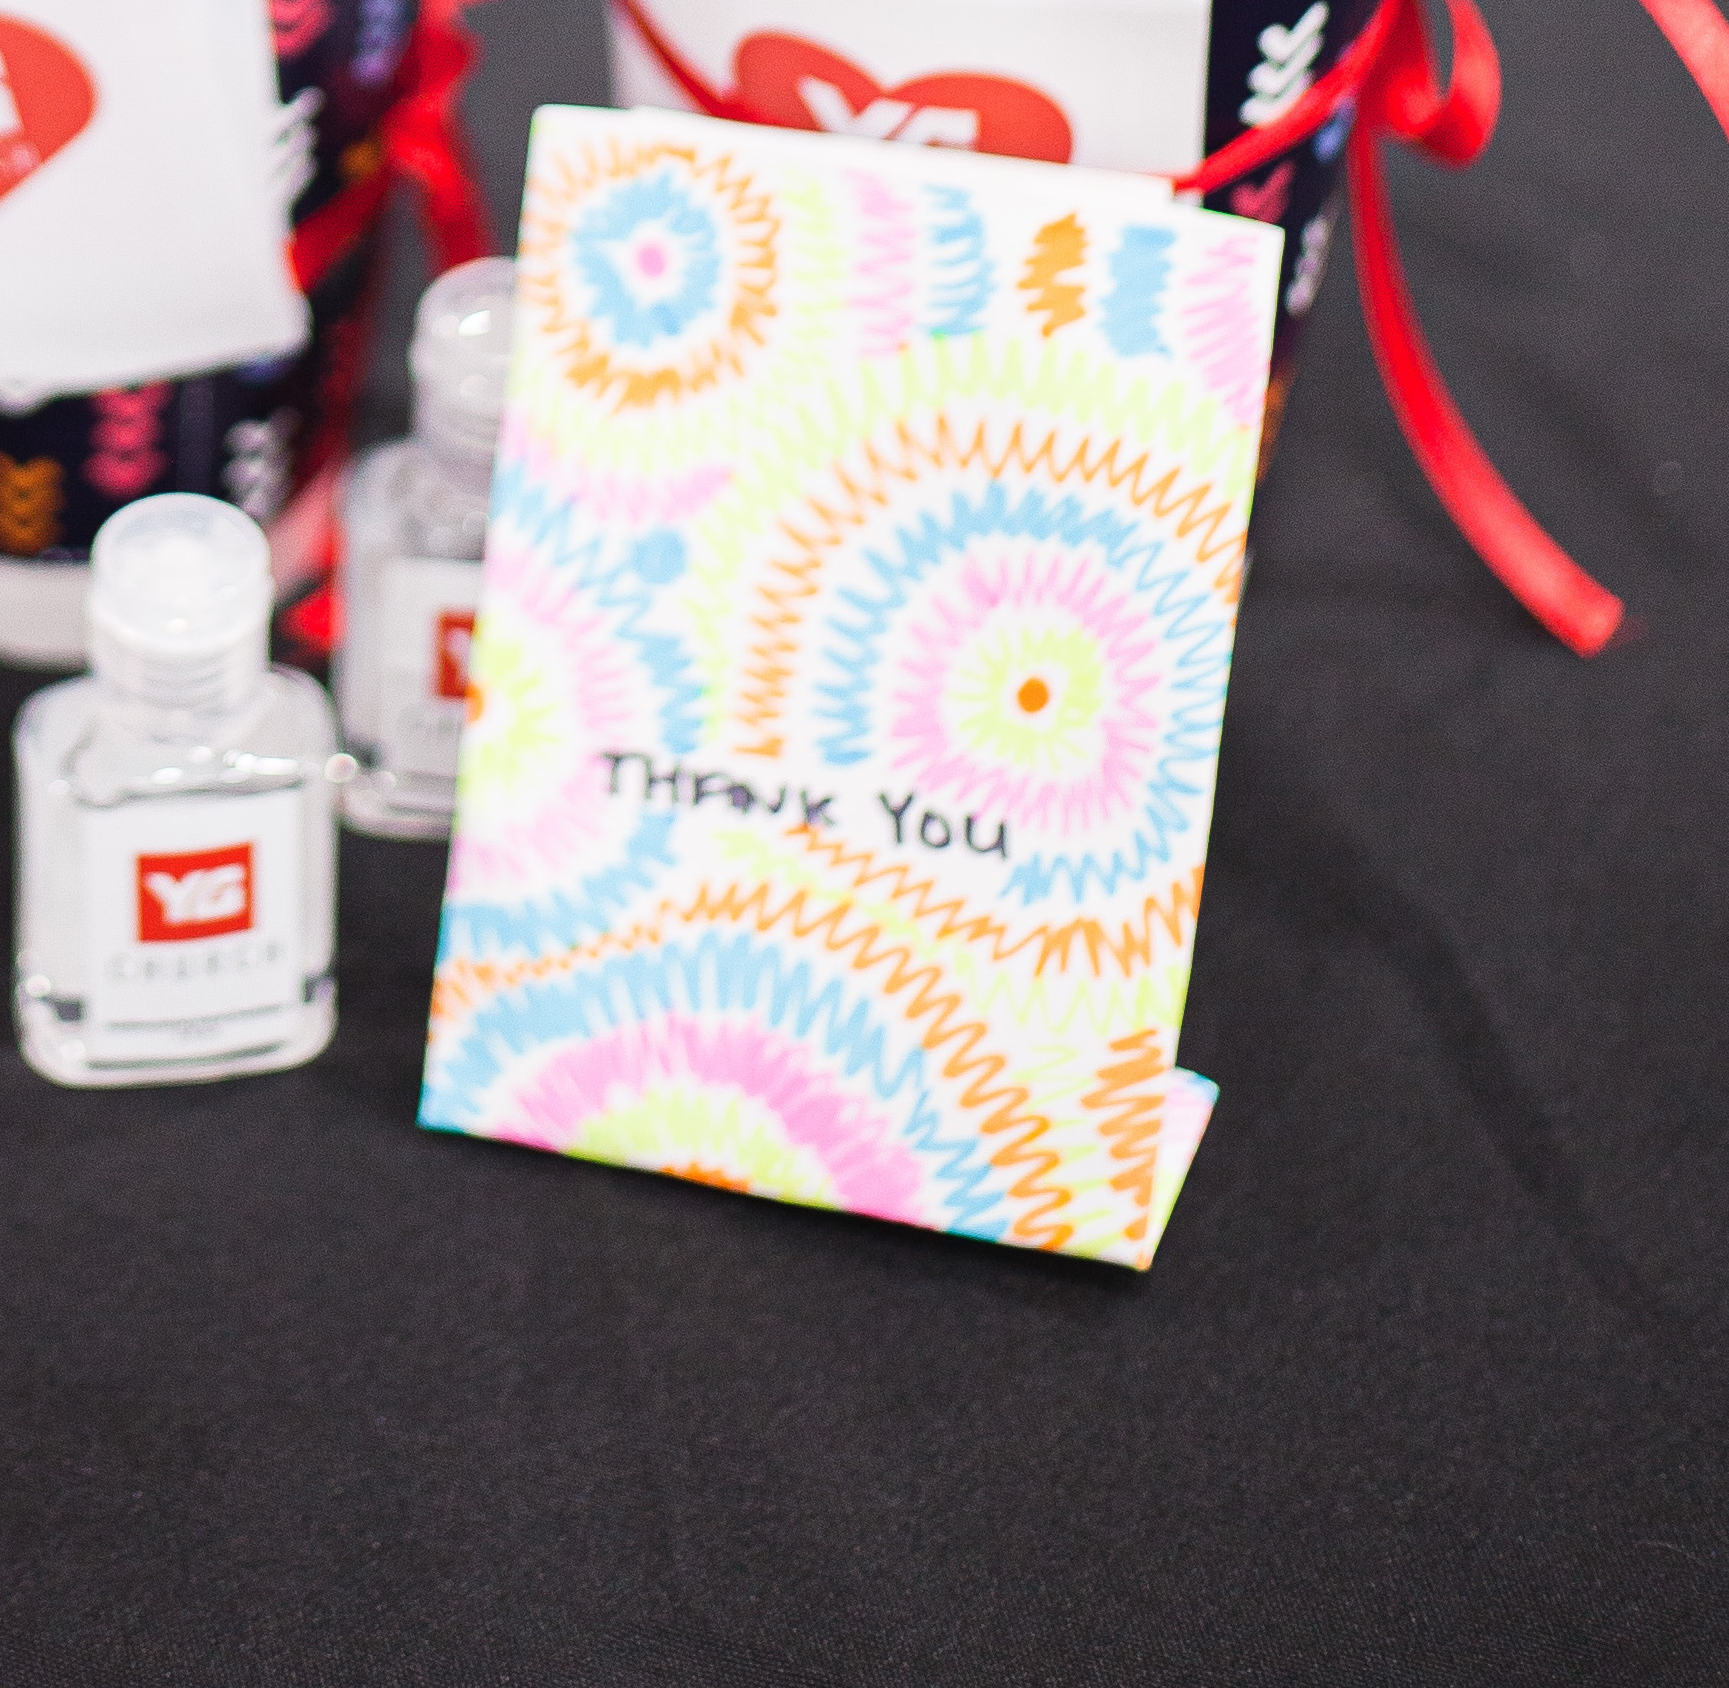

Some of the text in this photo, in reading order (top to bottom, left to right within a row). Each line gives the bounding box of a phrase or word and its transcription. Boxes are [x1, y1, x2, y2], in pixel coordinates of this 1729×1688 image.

[602, 752, 1009, 859] THANK YOU
[144, 864, 245, 923] YG
